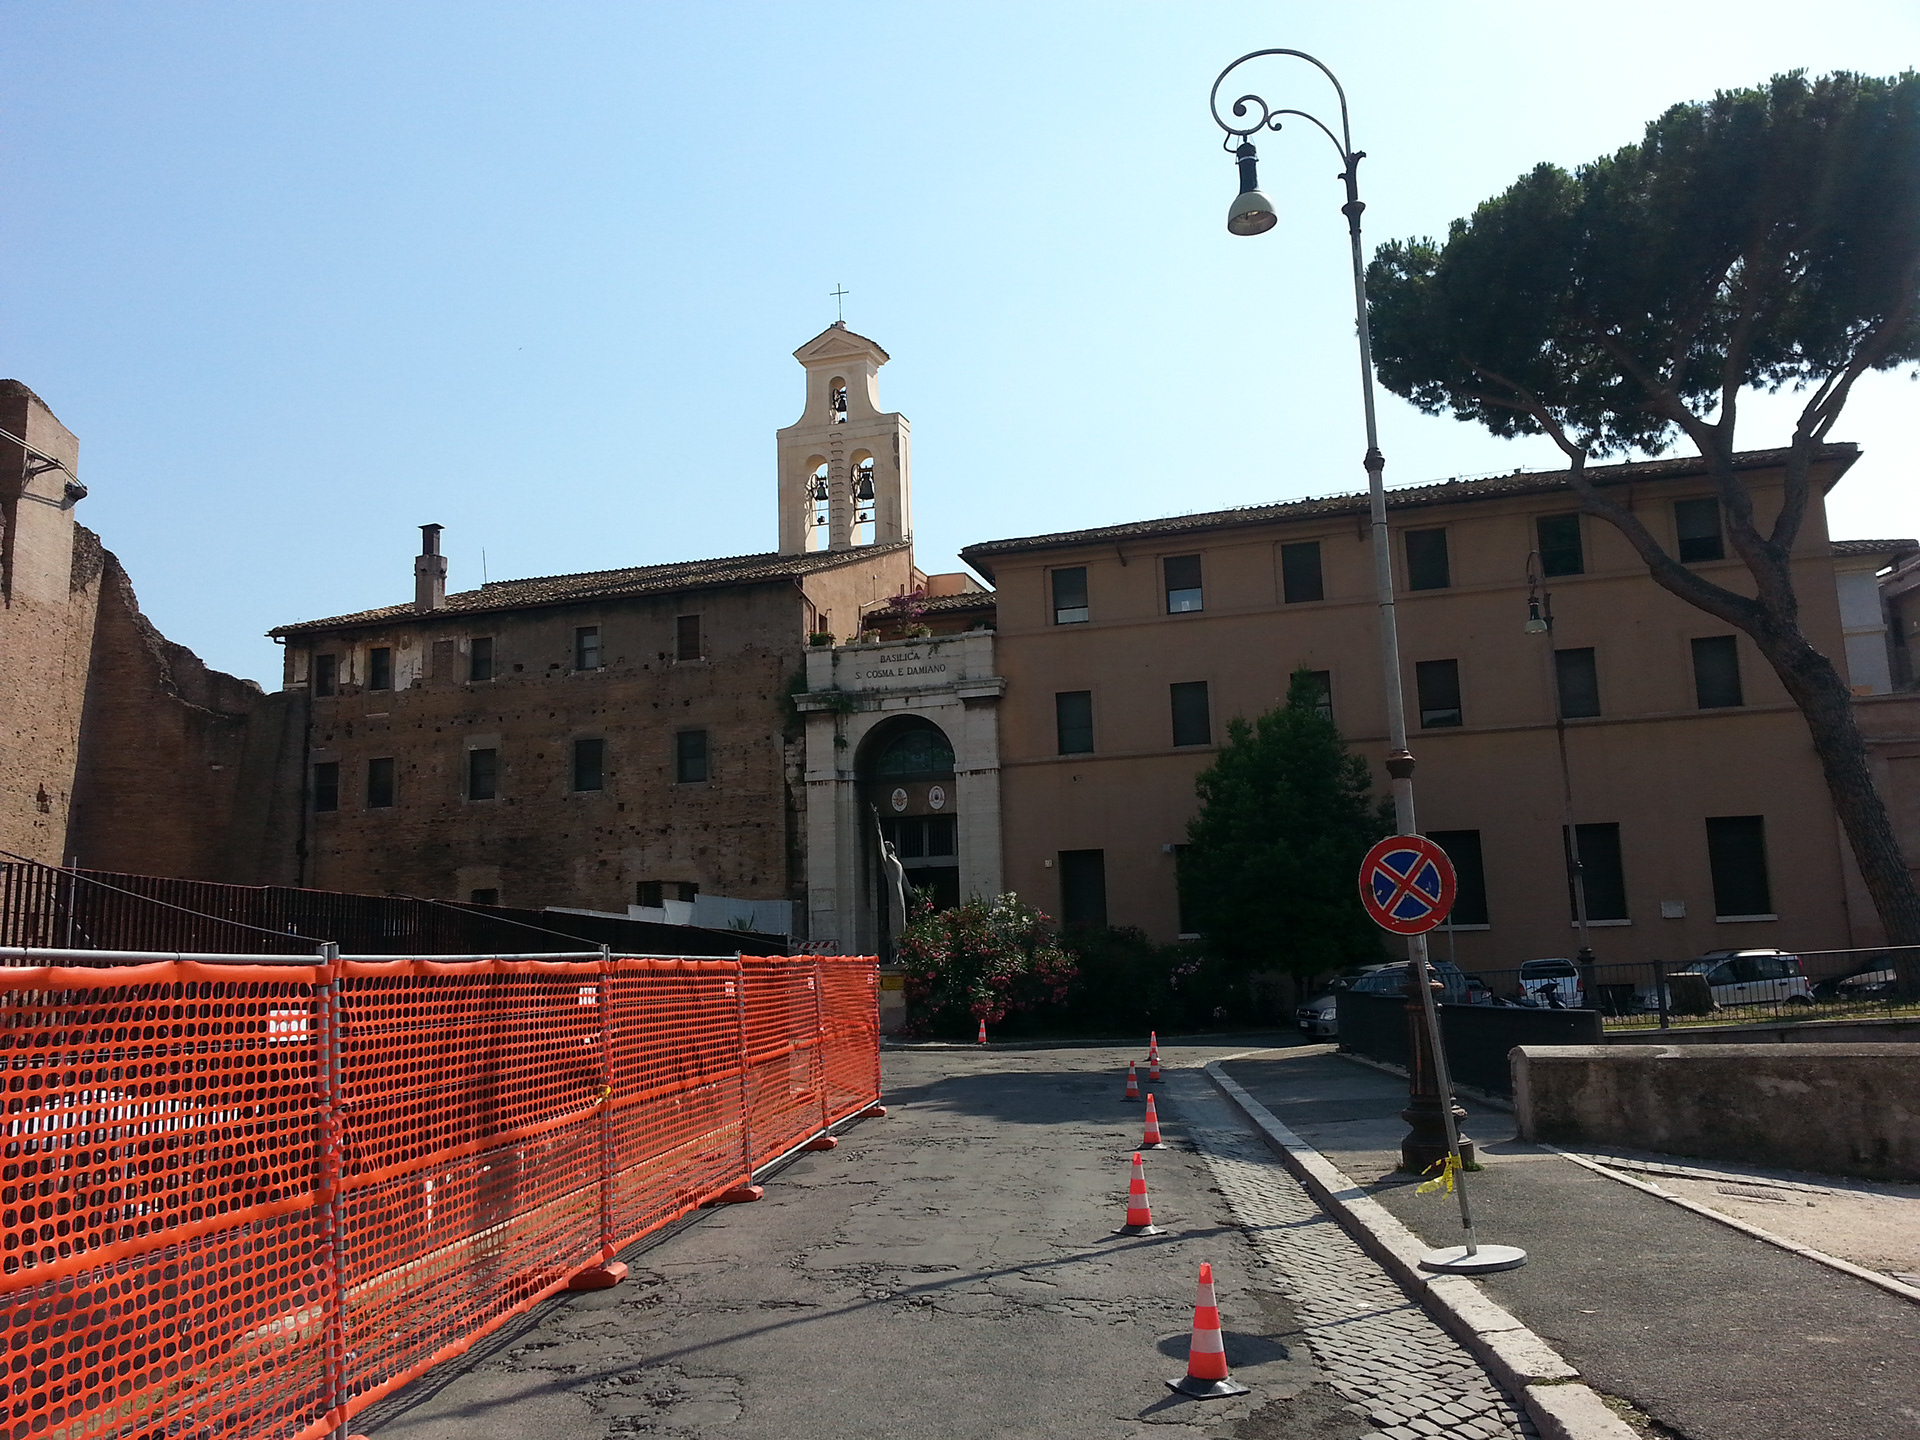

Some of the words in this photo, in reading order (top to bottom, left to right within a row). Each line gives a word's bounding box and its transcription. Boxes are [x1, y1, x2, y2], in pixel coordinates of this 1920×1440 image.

[880, 652, 920, 663] BASILICA
[866, 669, 894, 679] COSMA
[898, 668, 904, 676] E
[907, 664, 946, 675] DAMIANO
